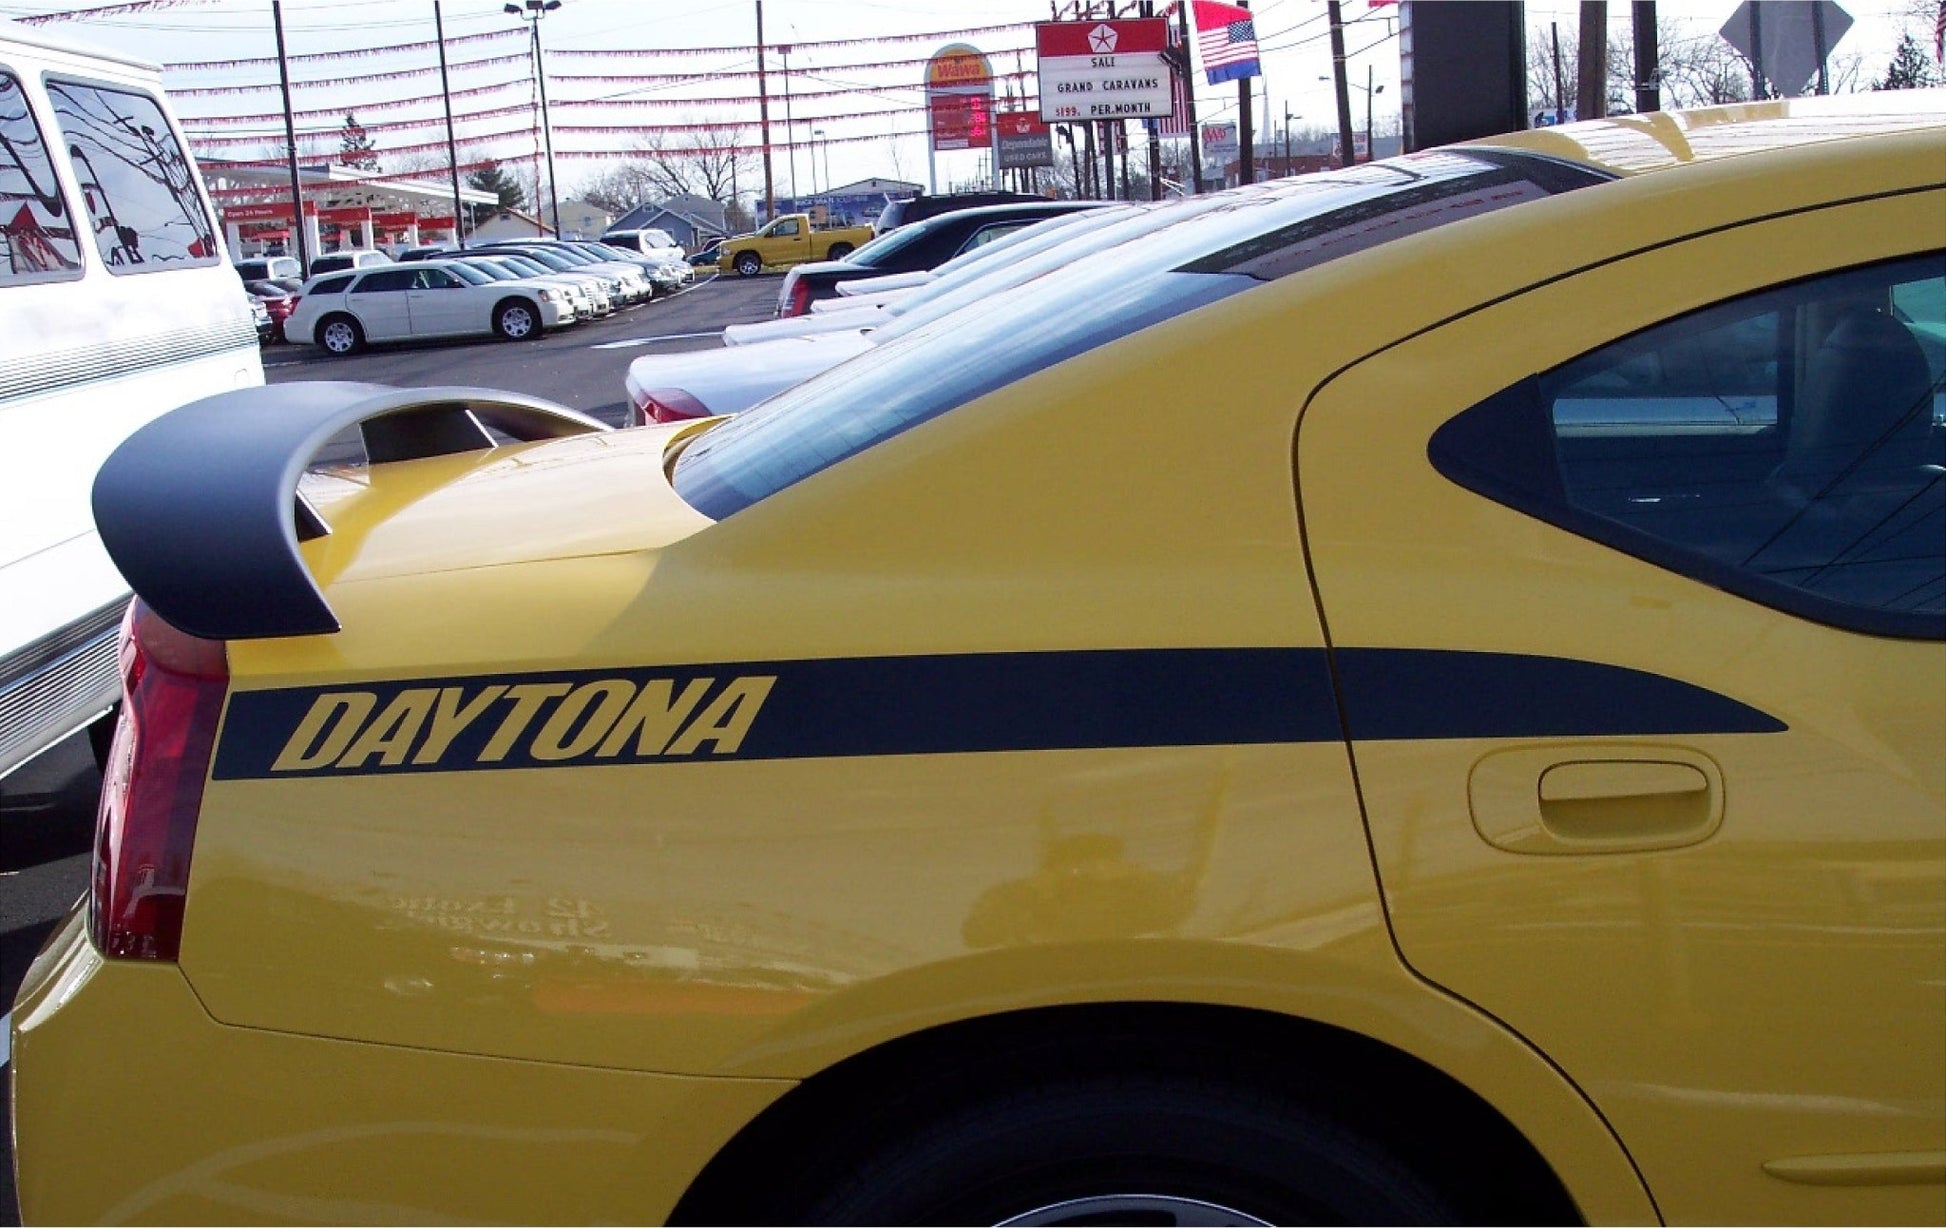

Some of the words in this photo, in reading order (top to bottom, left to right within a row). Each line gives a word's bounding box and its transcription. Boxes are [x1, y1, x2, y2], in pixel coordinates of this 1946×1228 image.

[1091, 57, 1115, 68] SALE
[937, 63, 981, 77] Wawa
[1057, 82, 1093, 93] GRAND
[1103, 79, 1158, 91] CARAVANS
[271, 676, 777, 771] DAYTONA
